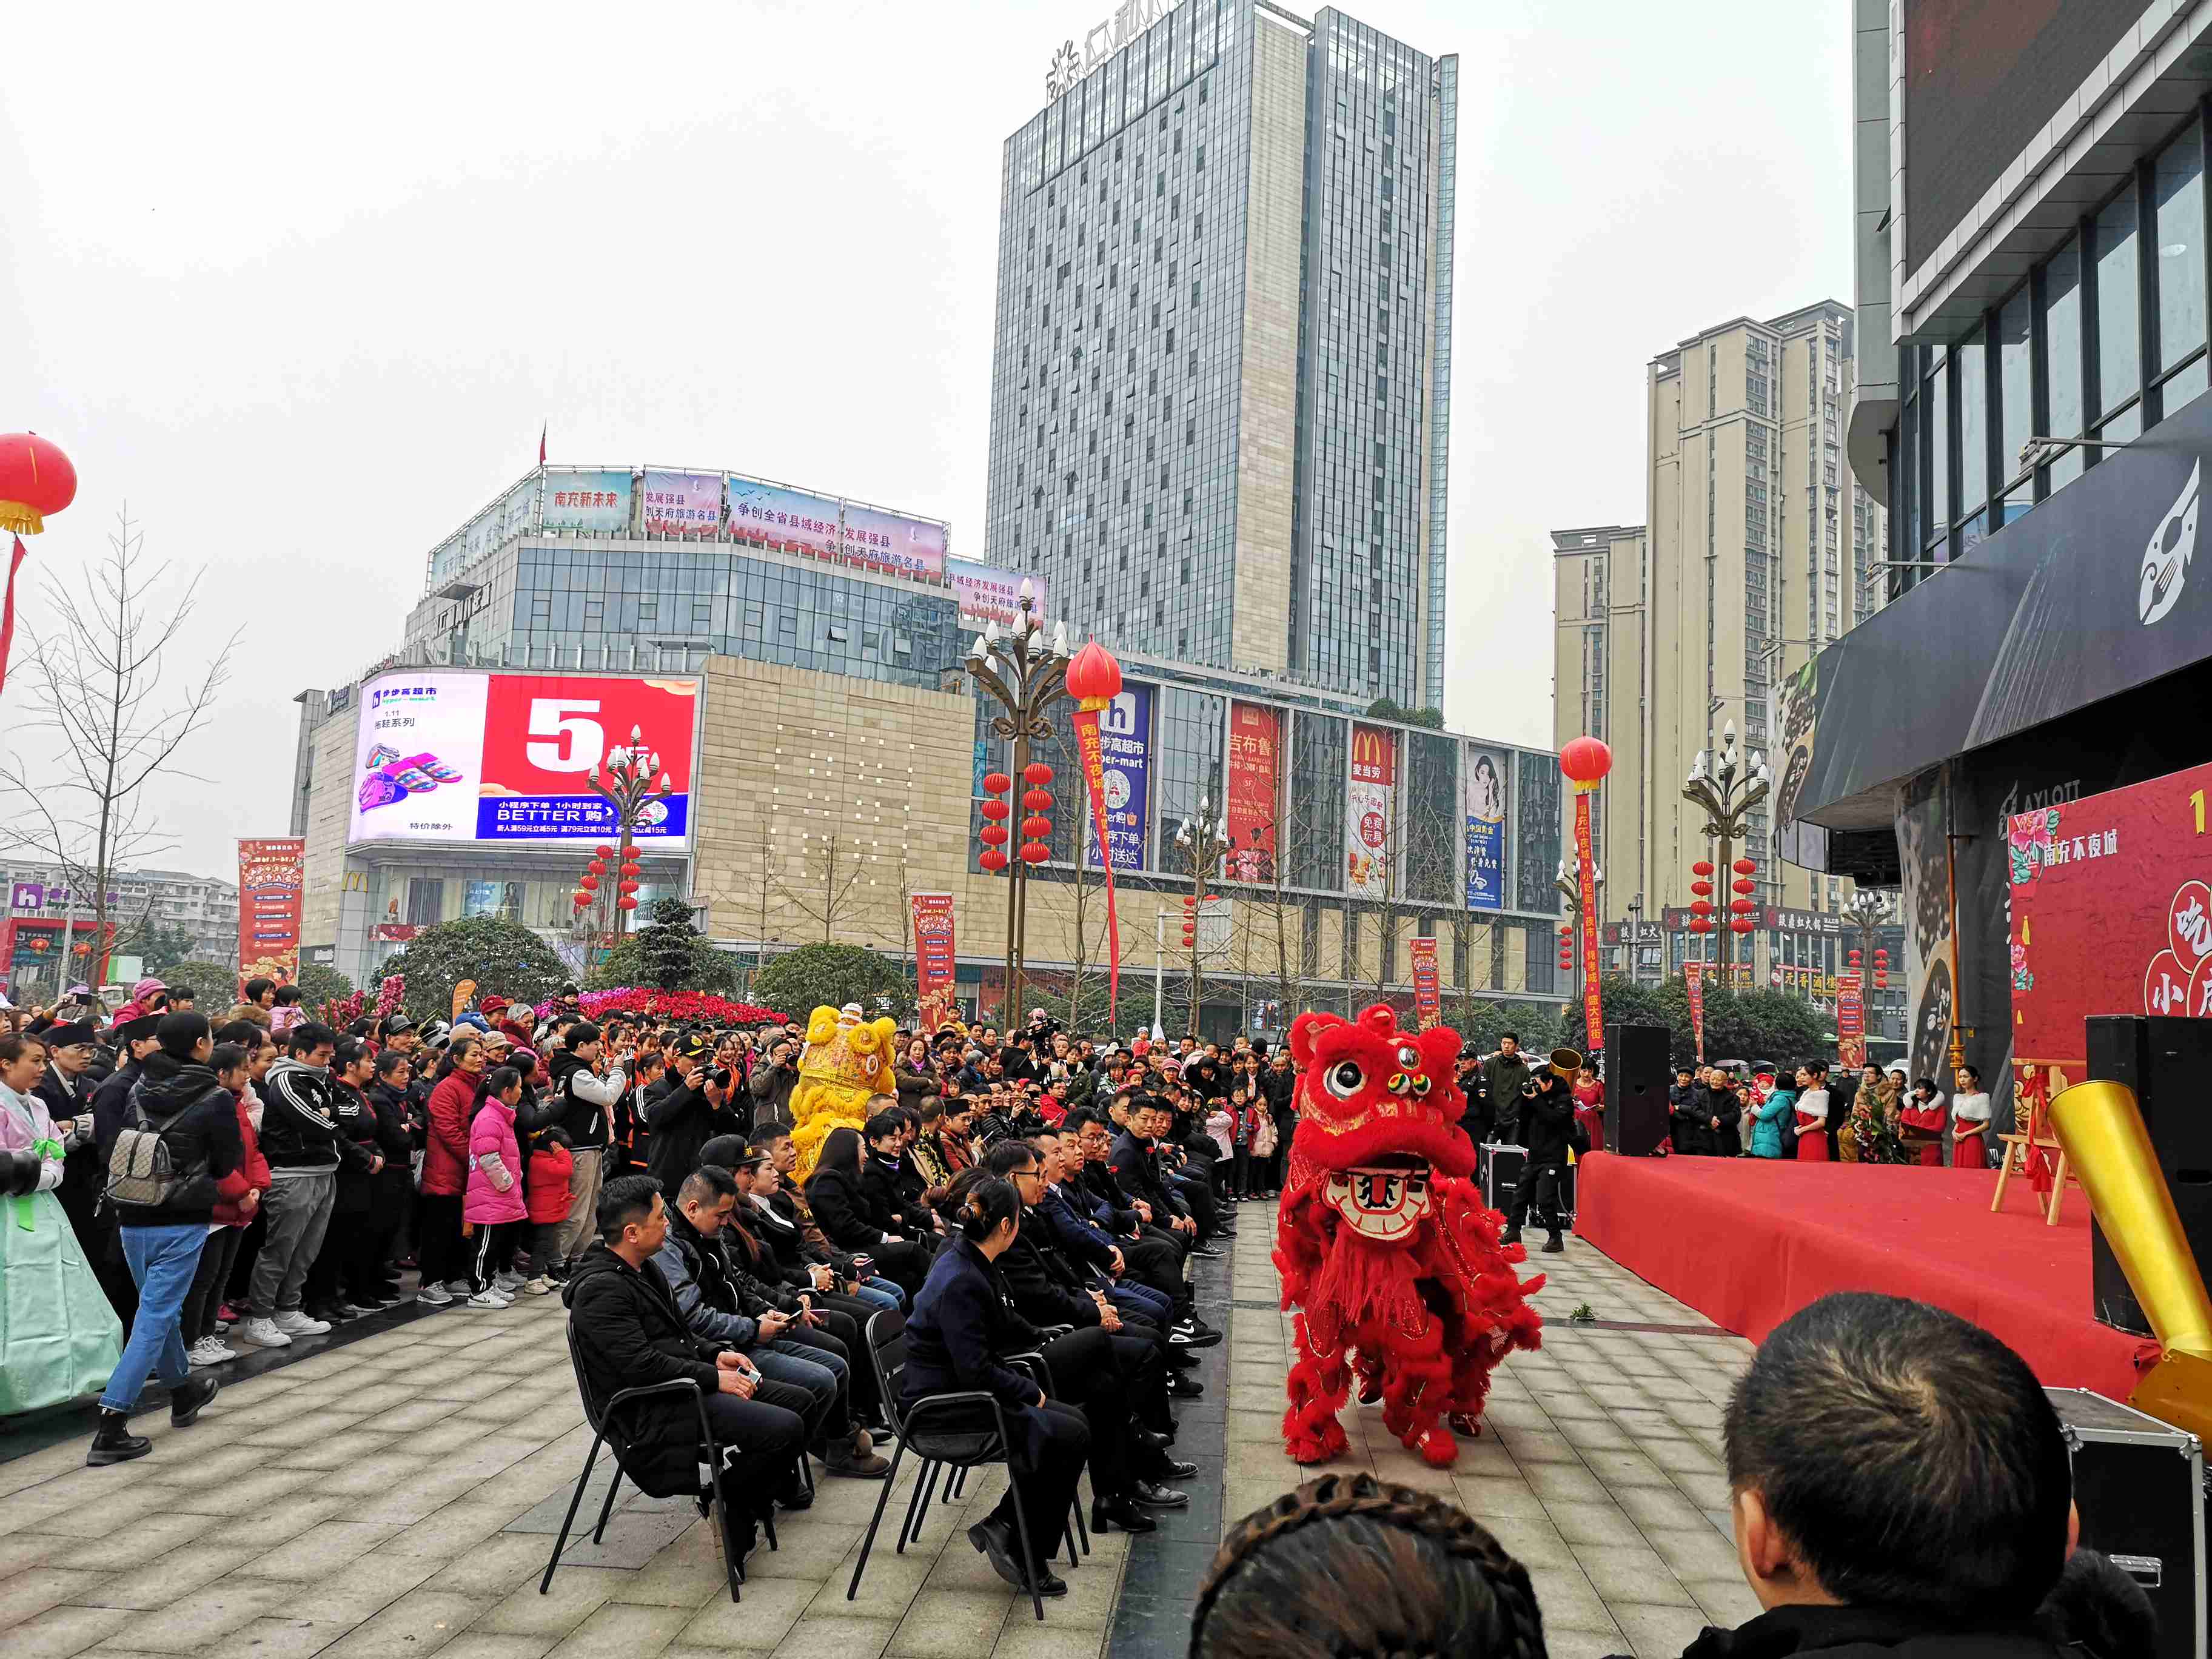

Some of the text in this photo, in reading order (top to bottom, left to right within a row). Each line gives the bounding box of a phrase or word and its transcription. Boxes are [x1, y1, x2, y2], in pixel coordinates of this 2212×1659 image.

[554, 492, 617, 508] 南充新未来
[645, 492, 685, 505] 发展强县
[845, 526, 891, 548] 发展强县
[526, 698, 605, 773] 5
[1353, 763, 1381, 779] 麦当劳
[497, 809, 602, 822] BETTER 购
[1364, 816, 1382, 830] 免费
[409, 822, 454, 831] 特价除外
[1364, 830, 1382, 843] 玩具
[2044, 828, 2118, 868] 南充不夜城
